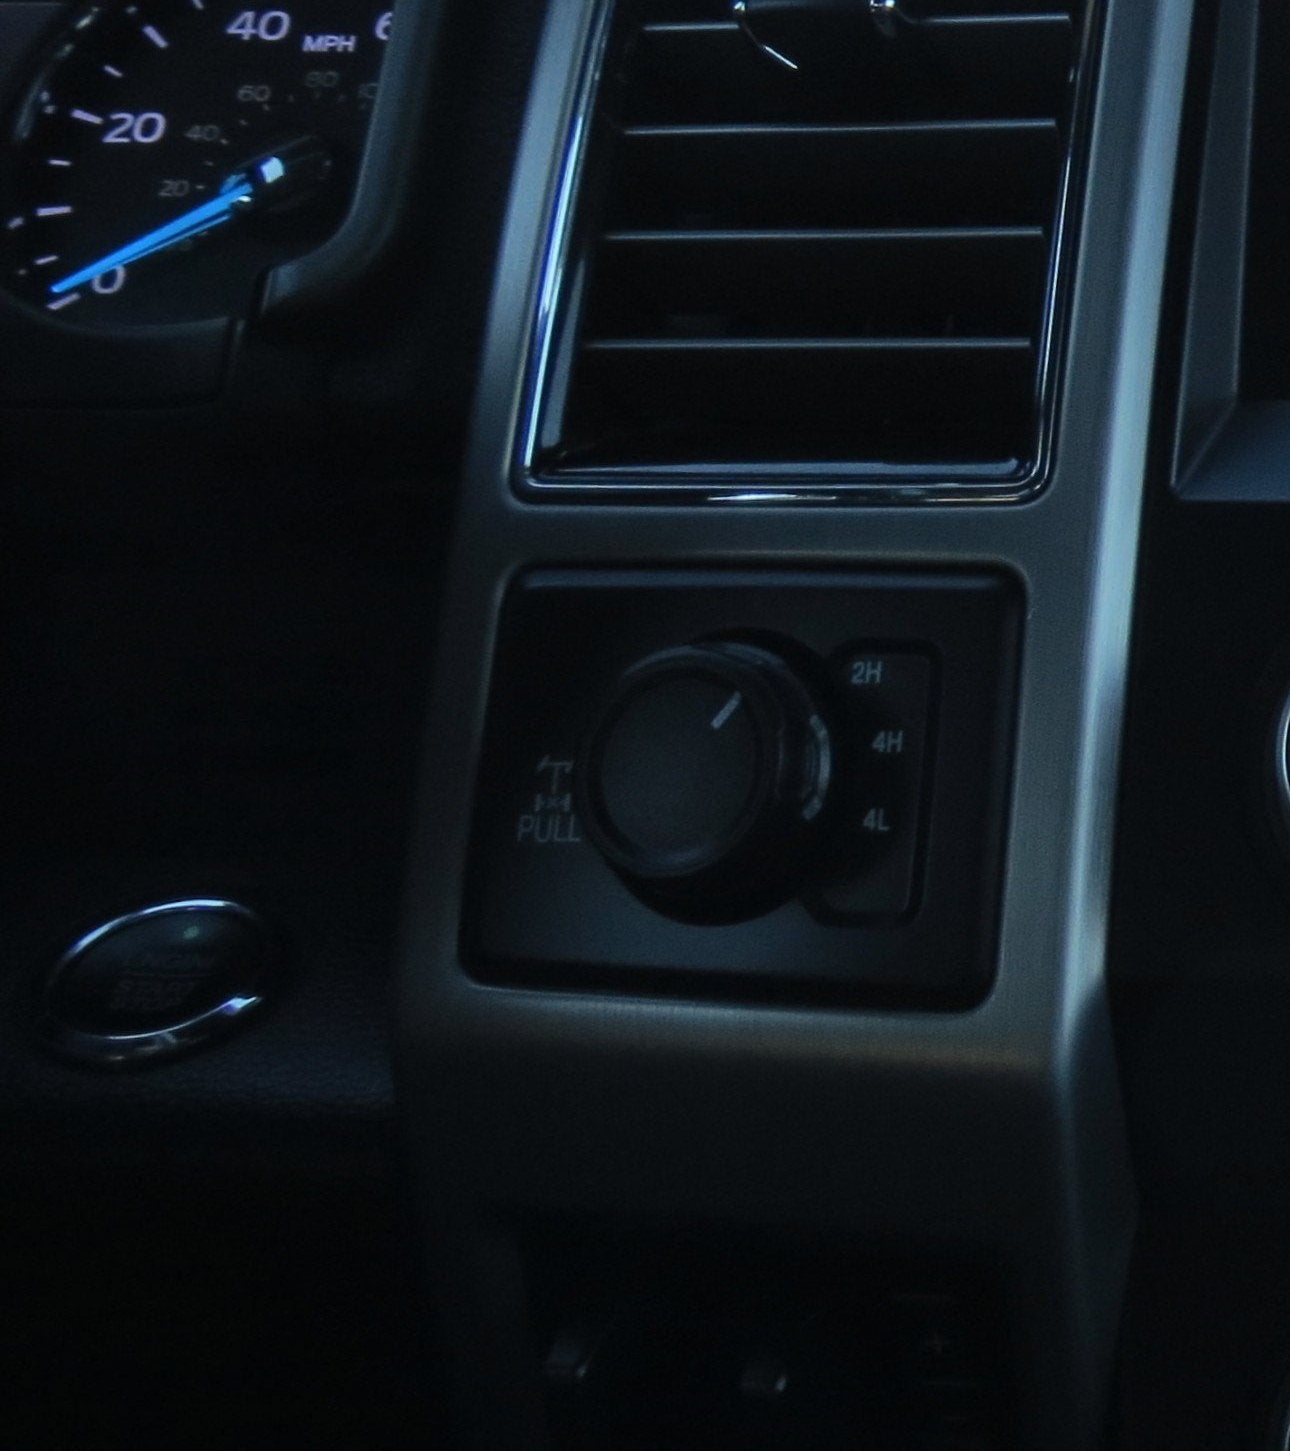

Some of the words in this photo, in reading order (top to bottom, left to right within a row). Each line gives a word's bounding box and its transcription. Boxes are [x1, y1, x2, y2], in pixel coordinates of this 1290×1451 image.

[225, 9, 292, 41] 40
[302, 33, 358, 53] MPH
[237, 85, 271, 103] 60
[102, 111, 167, 143] 20
[185, 124, 220, 142] 40
[158, 180, 190, 198] 20
[90, 264, 126, 294] 0
[849, 661, 882, 685] 2H
[871, 730, 904, 754] 4H
[516, 813, 582, 843] PULL
[862, 808, 890, 832] 4L
